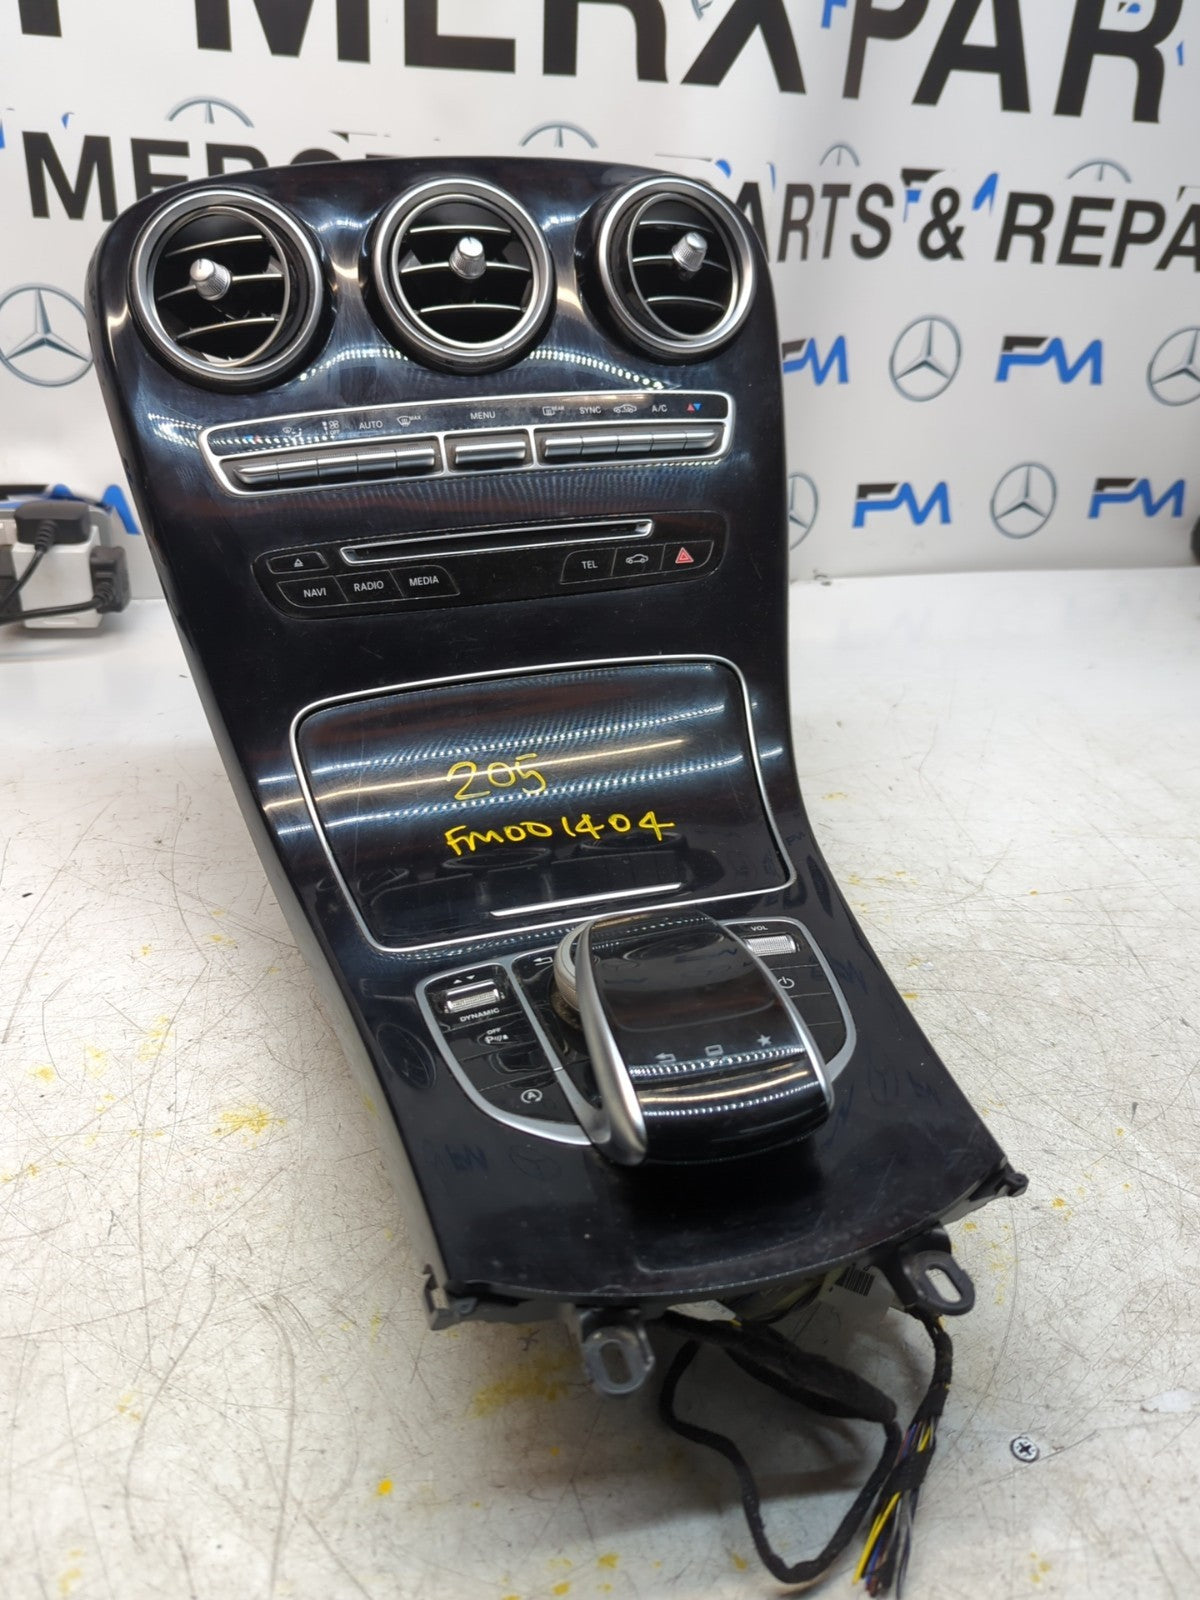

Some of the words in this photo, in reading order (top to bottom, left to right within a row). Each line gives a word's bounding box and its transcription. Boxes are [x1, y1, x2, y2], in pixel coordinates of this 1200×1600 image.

[918, 187, 965, 261] &
[994, 335, 1103, 385] FM
[579, 406, 601, 415] SYNC
[652, 404, 668, 413] A/C
[470, 411, 496, 420] MENU
[359, 420, 383, 430] AUTO
[852, 480, 951, 528] FM
[1087, 477, 1186, 519] FM
[582, 560, 598, 569] TEL
[353, 580, 384, 592] RADIO
[409, 575, 439, 587] MEDIA
[303, 587, 327, 598] NAVI
[446, 753, 547, 800] 205
[459, 1007, 500, 1022] DYNAMIC
